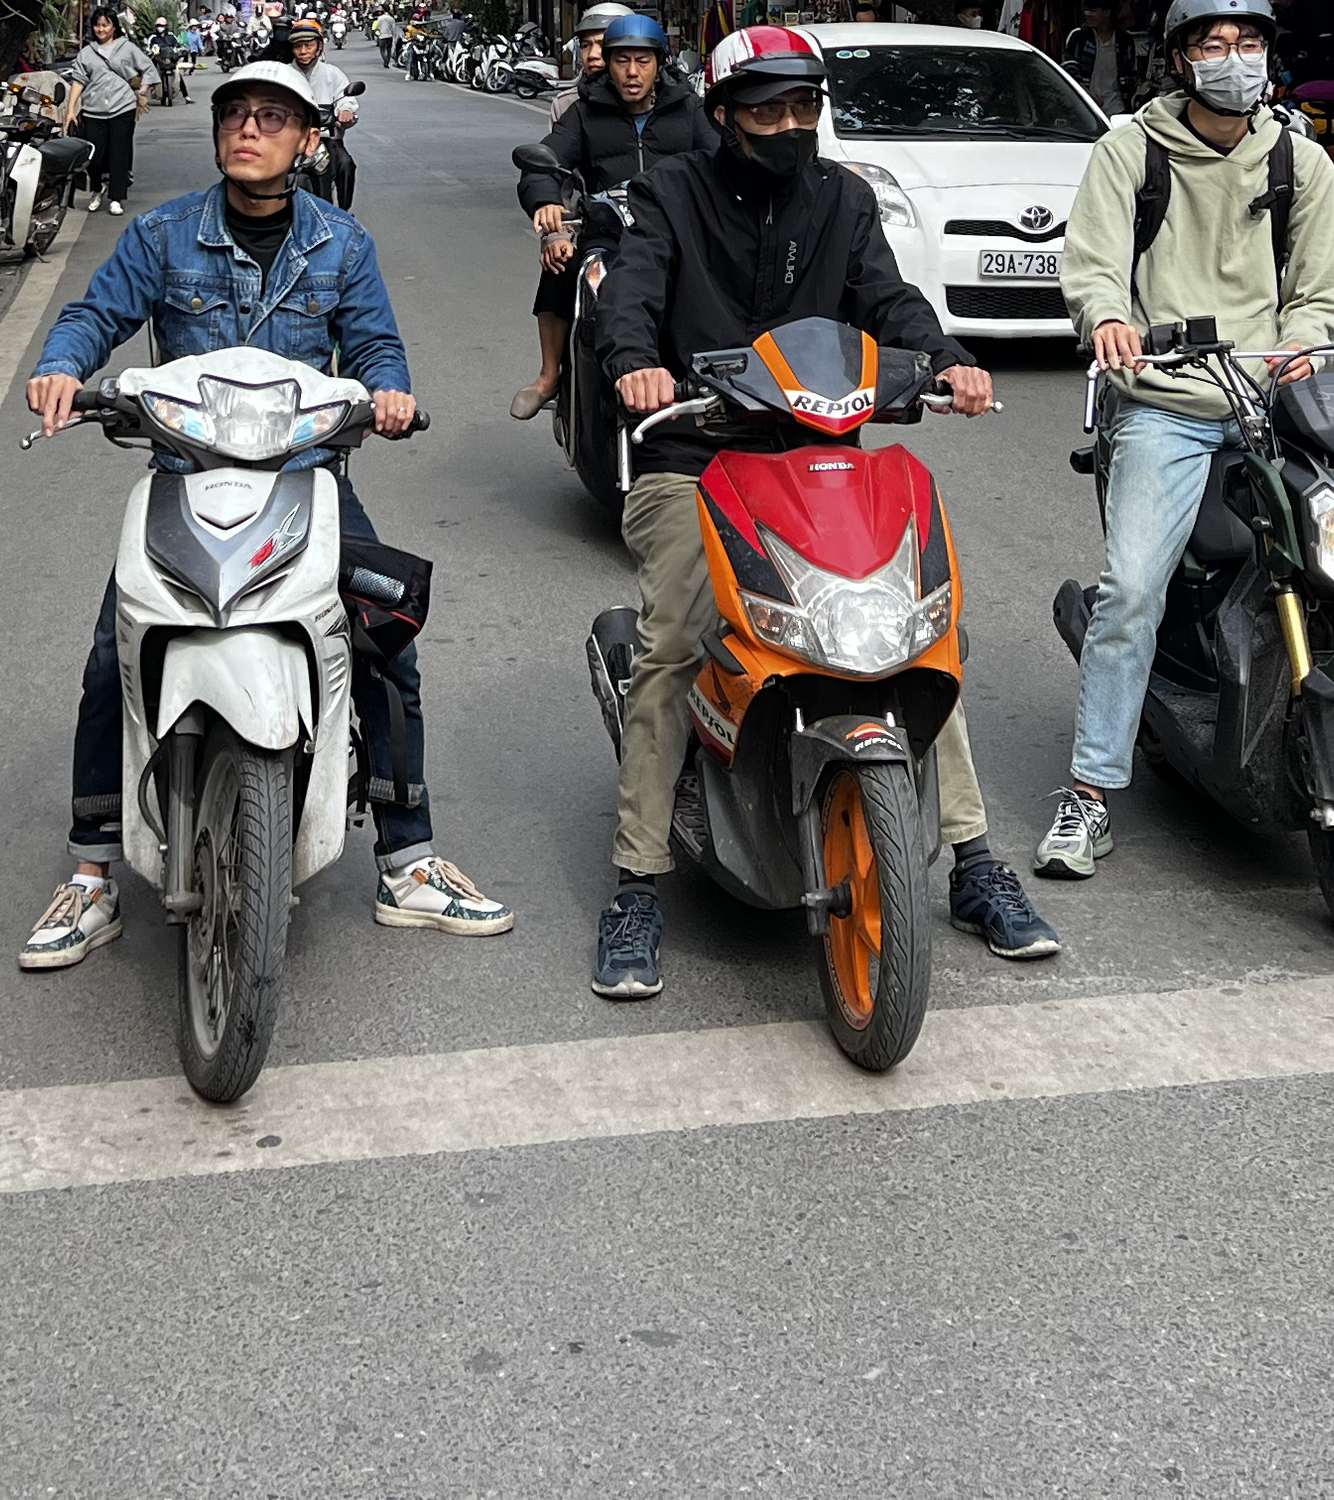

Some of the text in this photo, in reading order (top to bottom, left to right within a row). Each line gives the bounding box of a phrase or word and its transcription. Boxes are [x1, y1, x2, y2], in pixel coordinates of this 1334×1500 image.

[793, 392, 873, 416] REPSOL
[808, 462, 855, 472] HONDA
[205, 481, 252, 491] HONDA
[689, 687, 735, 745] REPSOL
[855, 736, 903, 752] REPSOL
